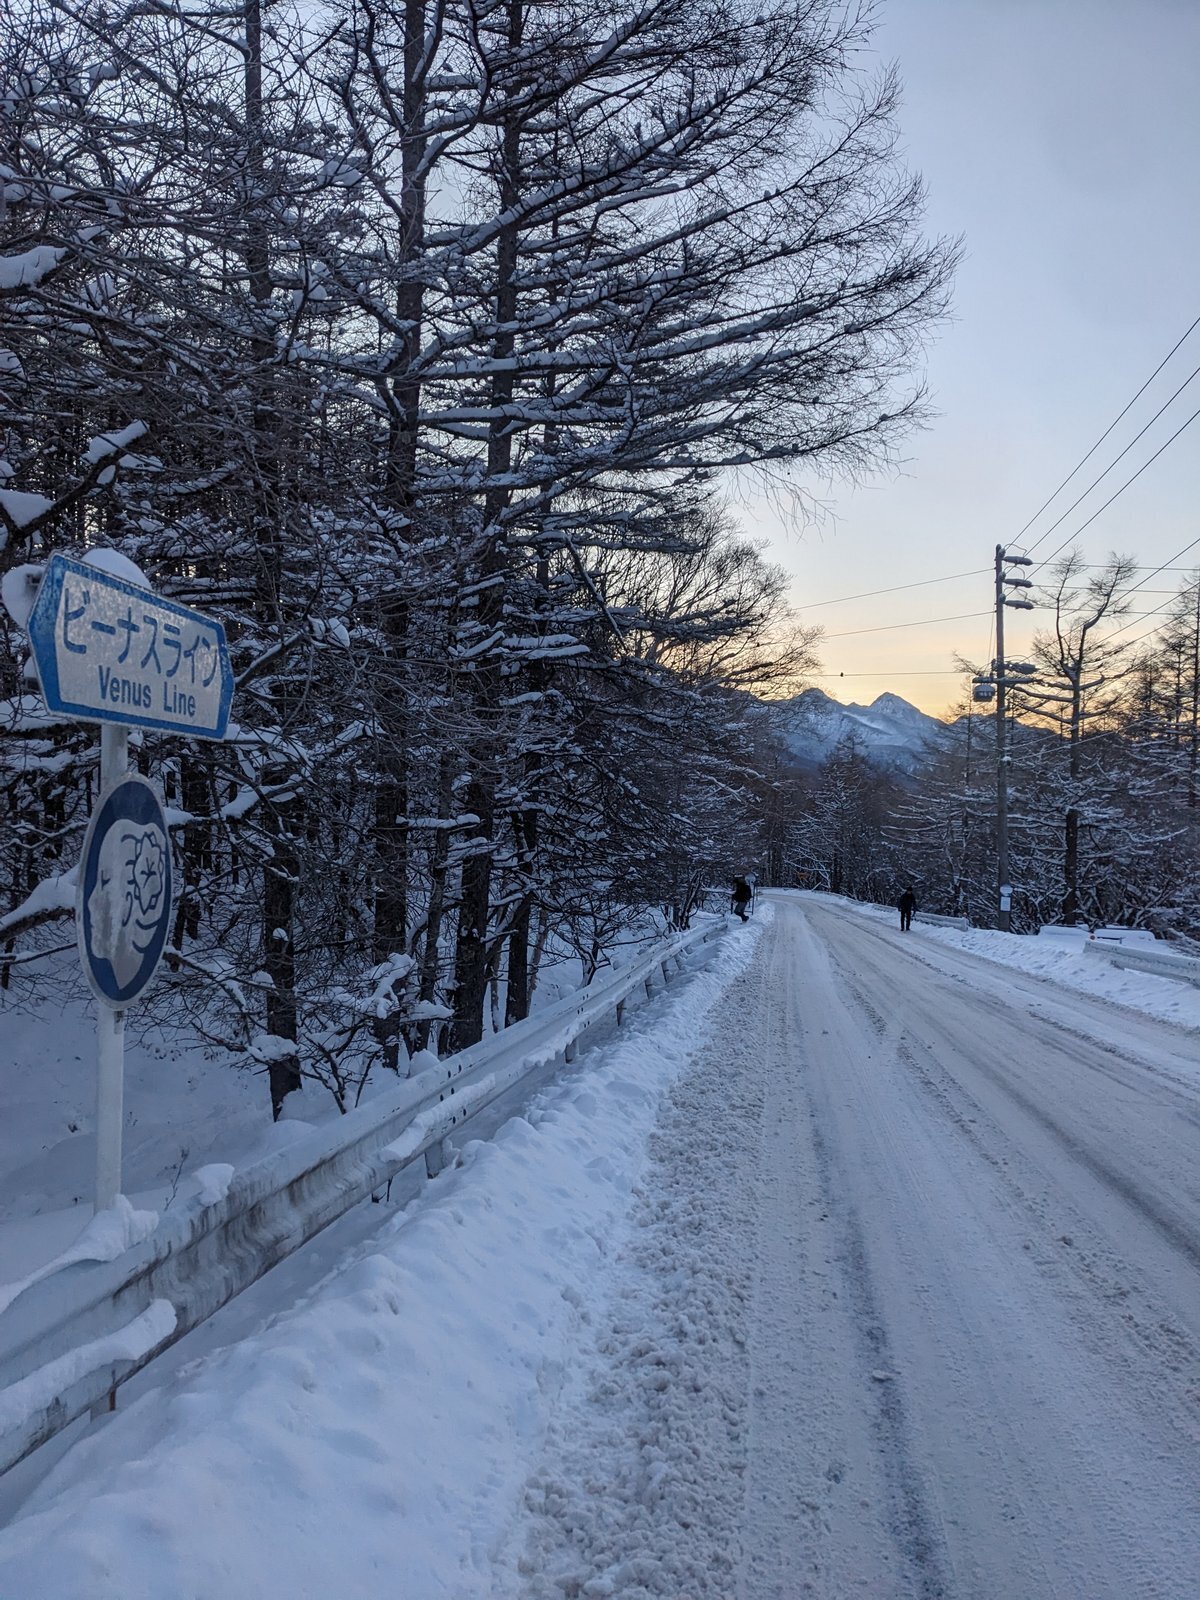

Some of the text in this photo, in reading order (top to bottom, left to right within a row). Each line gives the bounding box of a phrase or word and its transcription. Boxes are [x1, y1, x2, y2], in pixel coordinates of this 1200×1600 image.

[63, 588, 218, 688] ビーナスライン
[98, 665, 197, 717] Venus Line
